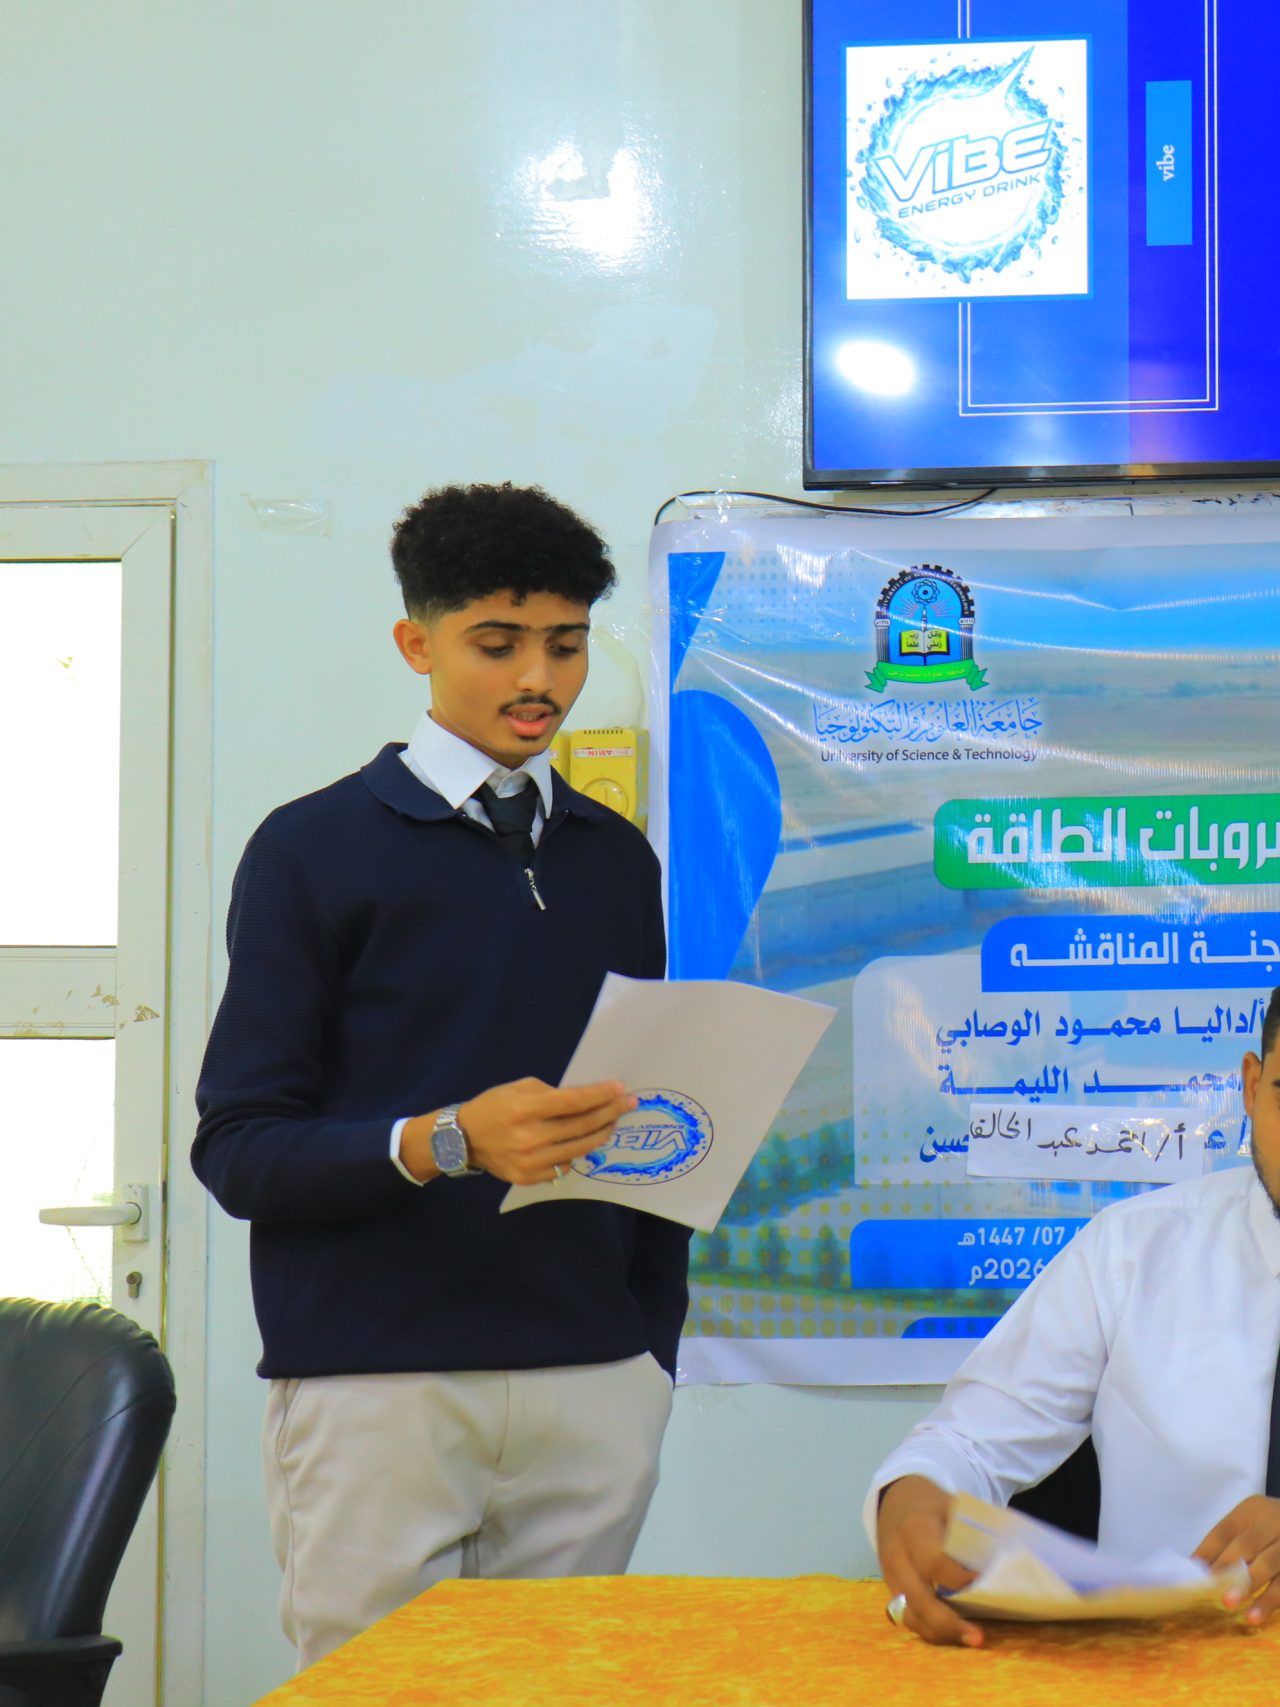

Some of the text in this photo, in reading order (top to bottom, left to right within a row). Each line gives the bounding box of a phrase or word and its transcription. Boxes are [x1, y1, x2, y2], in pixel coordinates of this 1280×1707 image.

[1156, 143, 1175, 182] vibe
[898, 174, 1040, 219] ENERGY DRINK
[886, 748, 900, 761] of
[902, 749, 950, 761] Science
[952, 750, 962, 761] &
[964, 748, 1037, 762] Technology
[968, 806, 1127, 864] الطاقة
[1010, 927, 1179, 967] المناقشه
[936, 1008, 1041, 1053] الوصابي
[1055, 1015, 1161, 1045] محمود
[1037, 1127, 1082, 1157] عبد
